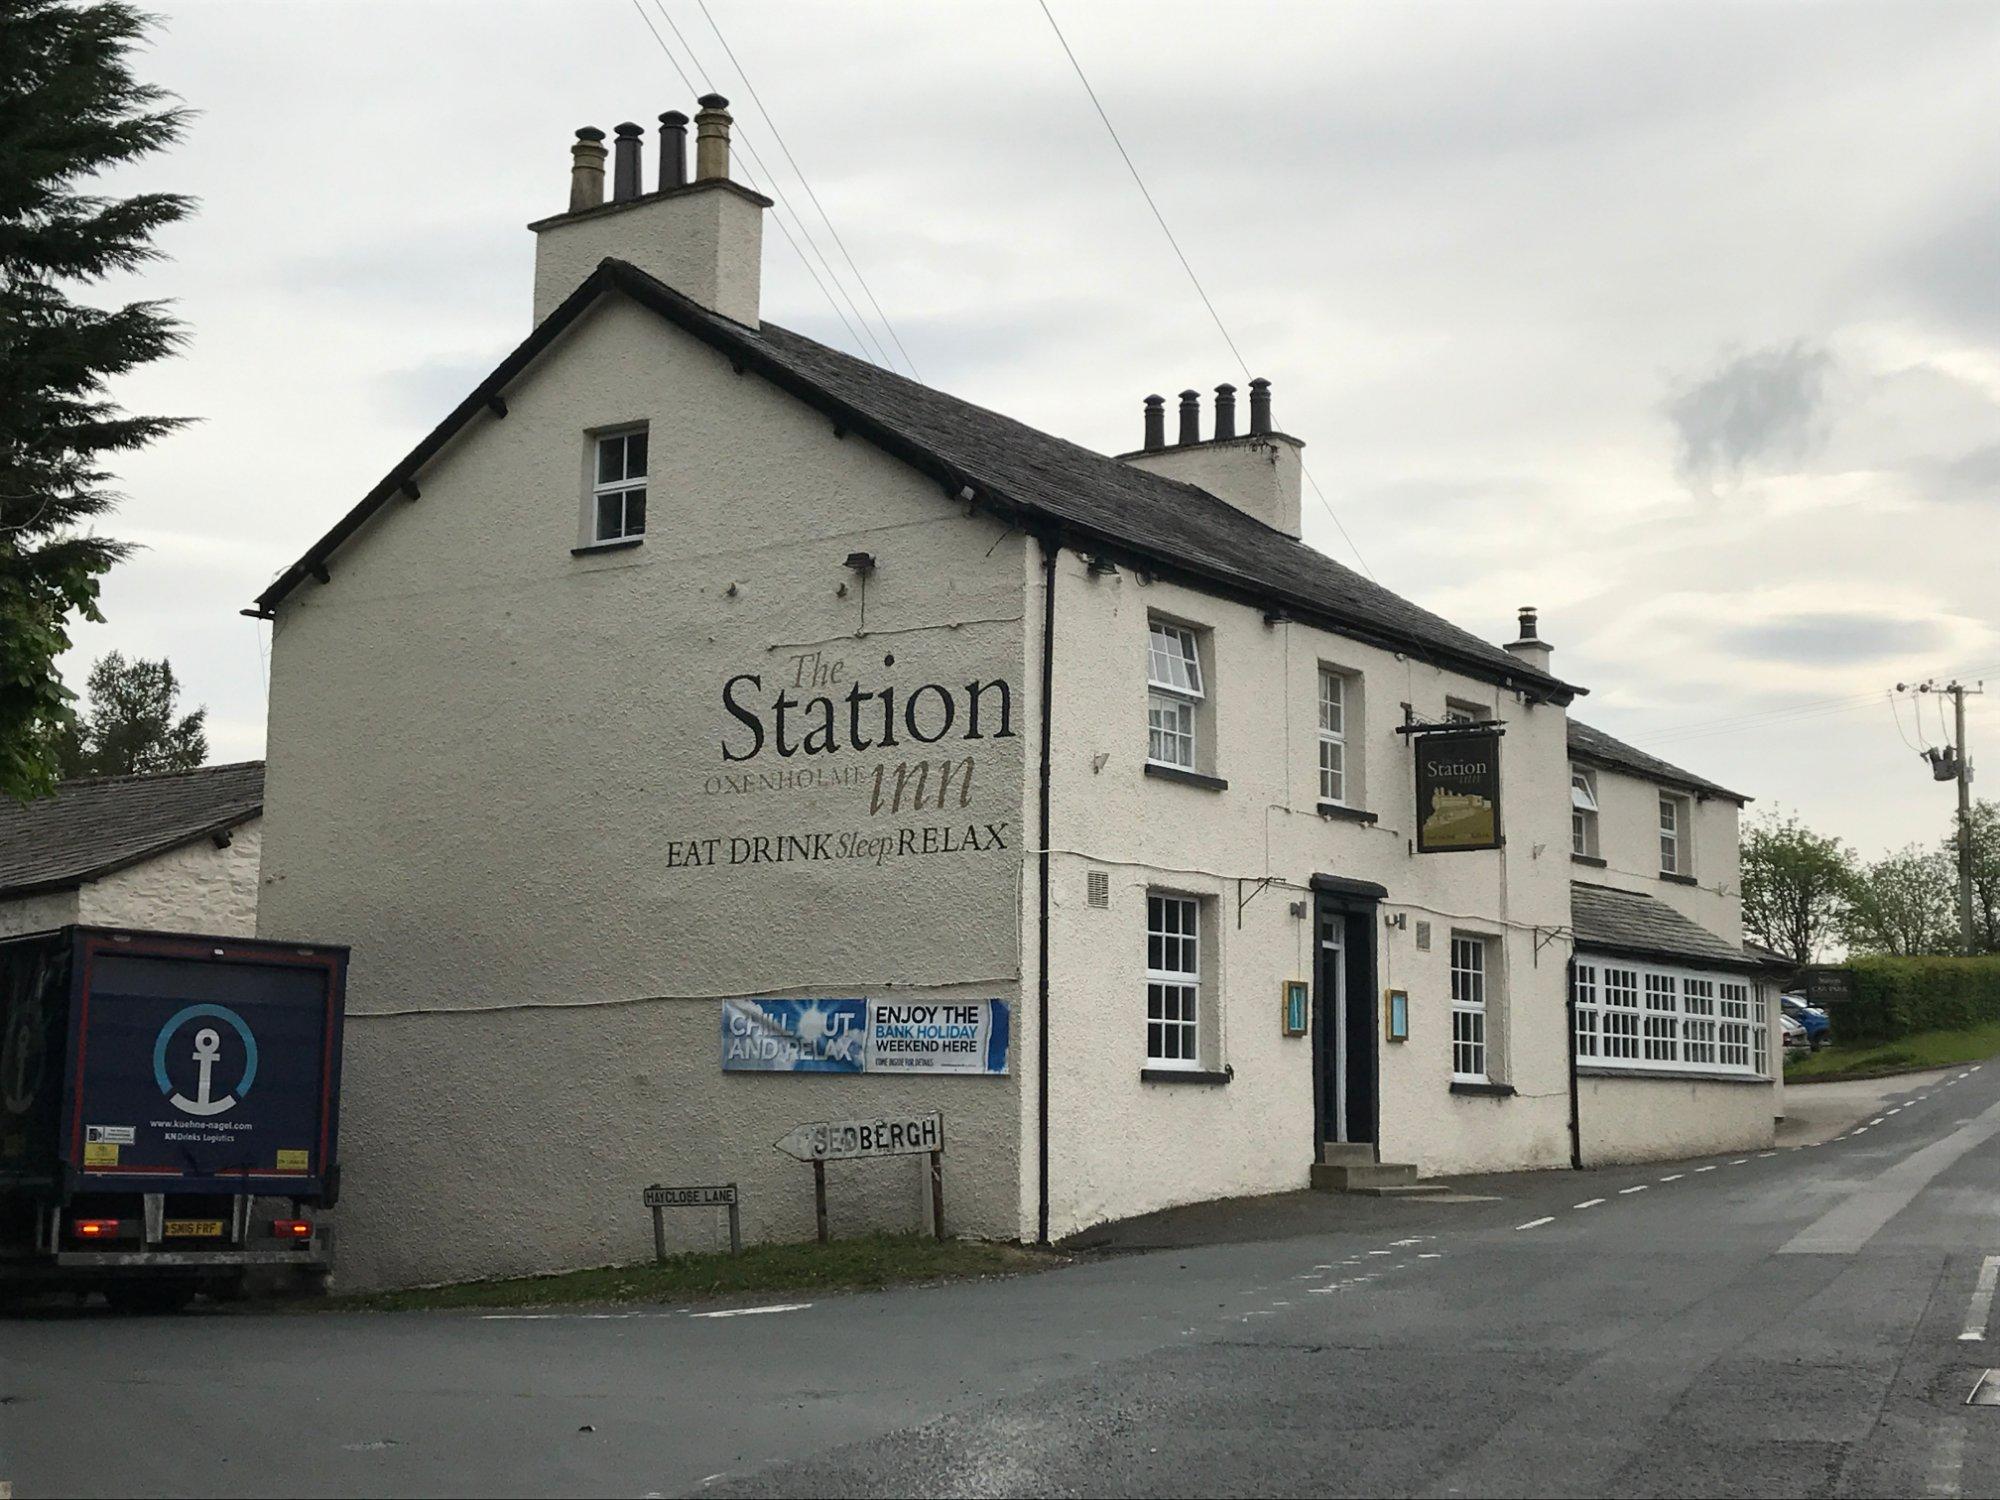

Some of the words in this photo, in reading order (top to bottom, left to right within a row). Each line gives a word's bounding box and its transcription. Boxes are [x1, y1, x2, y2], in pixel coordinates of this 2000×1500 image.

[790, 651, 845, 689] The
[721, 654, 1016, 762] Station
[1427, 760, 1487, 777] Station
[869, 756, 976, 817] inn
[666, 839, 721, 868] EAT
[730, 833, 833, 866] DRINK
[836, 832, 894, 867] Sleep
[896, 822, 1009, 856] RELAX
[729, 1012, 796, 1037] CHILL
[876, 1006, 938, 1024] ENJOY
[943, 1006, 979, 1024] THE
[876, 1025, 914, 1038] BANK
[916, 1025, 978, 1039] HOLIDAY
[728, 1038, 779, 1061] AND
[785, 1038, 853, 1061] RELAX
[875, 1040, 939, 1053] WEEKEND
[943, 1040, 977, 1053] HERE
[150, 1119, 252, 1131] www.kuehne-nagel.com
[203, 1133, 235, 1143] Logistics
[813, 1119, 937, 1154] SEDBERGH
[647, 1190, 700, 1204] HAYCLOSE
[705, 1189, 734, 1203] LANE
